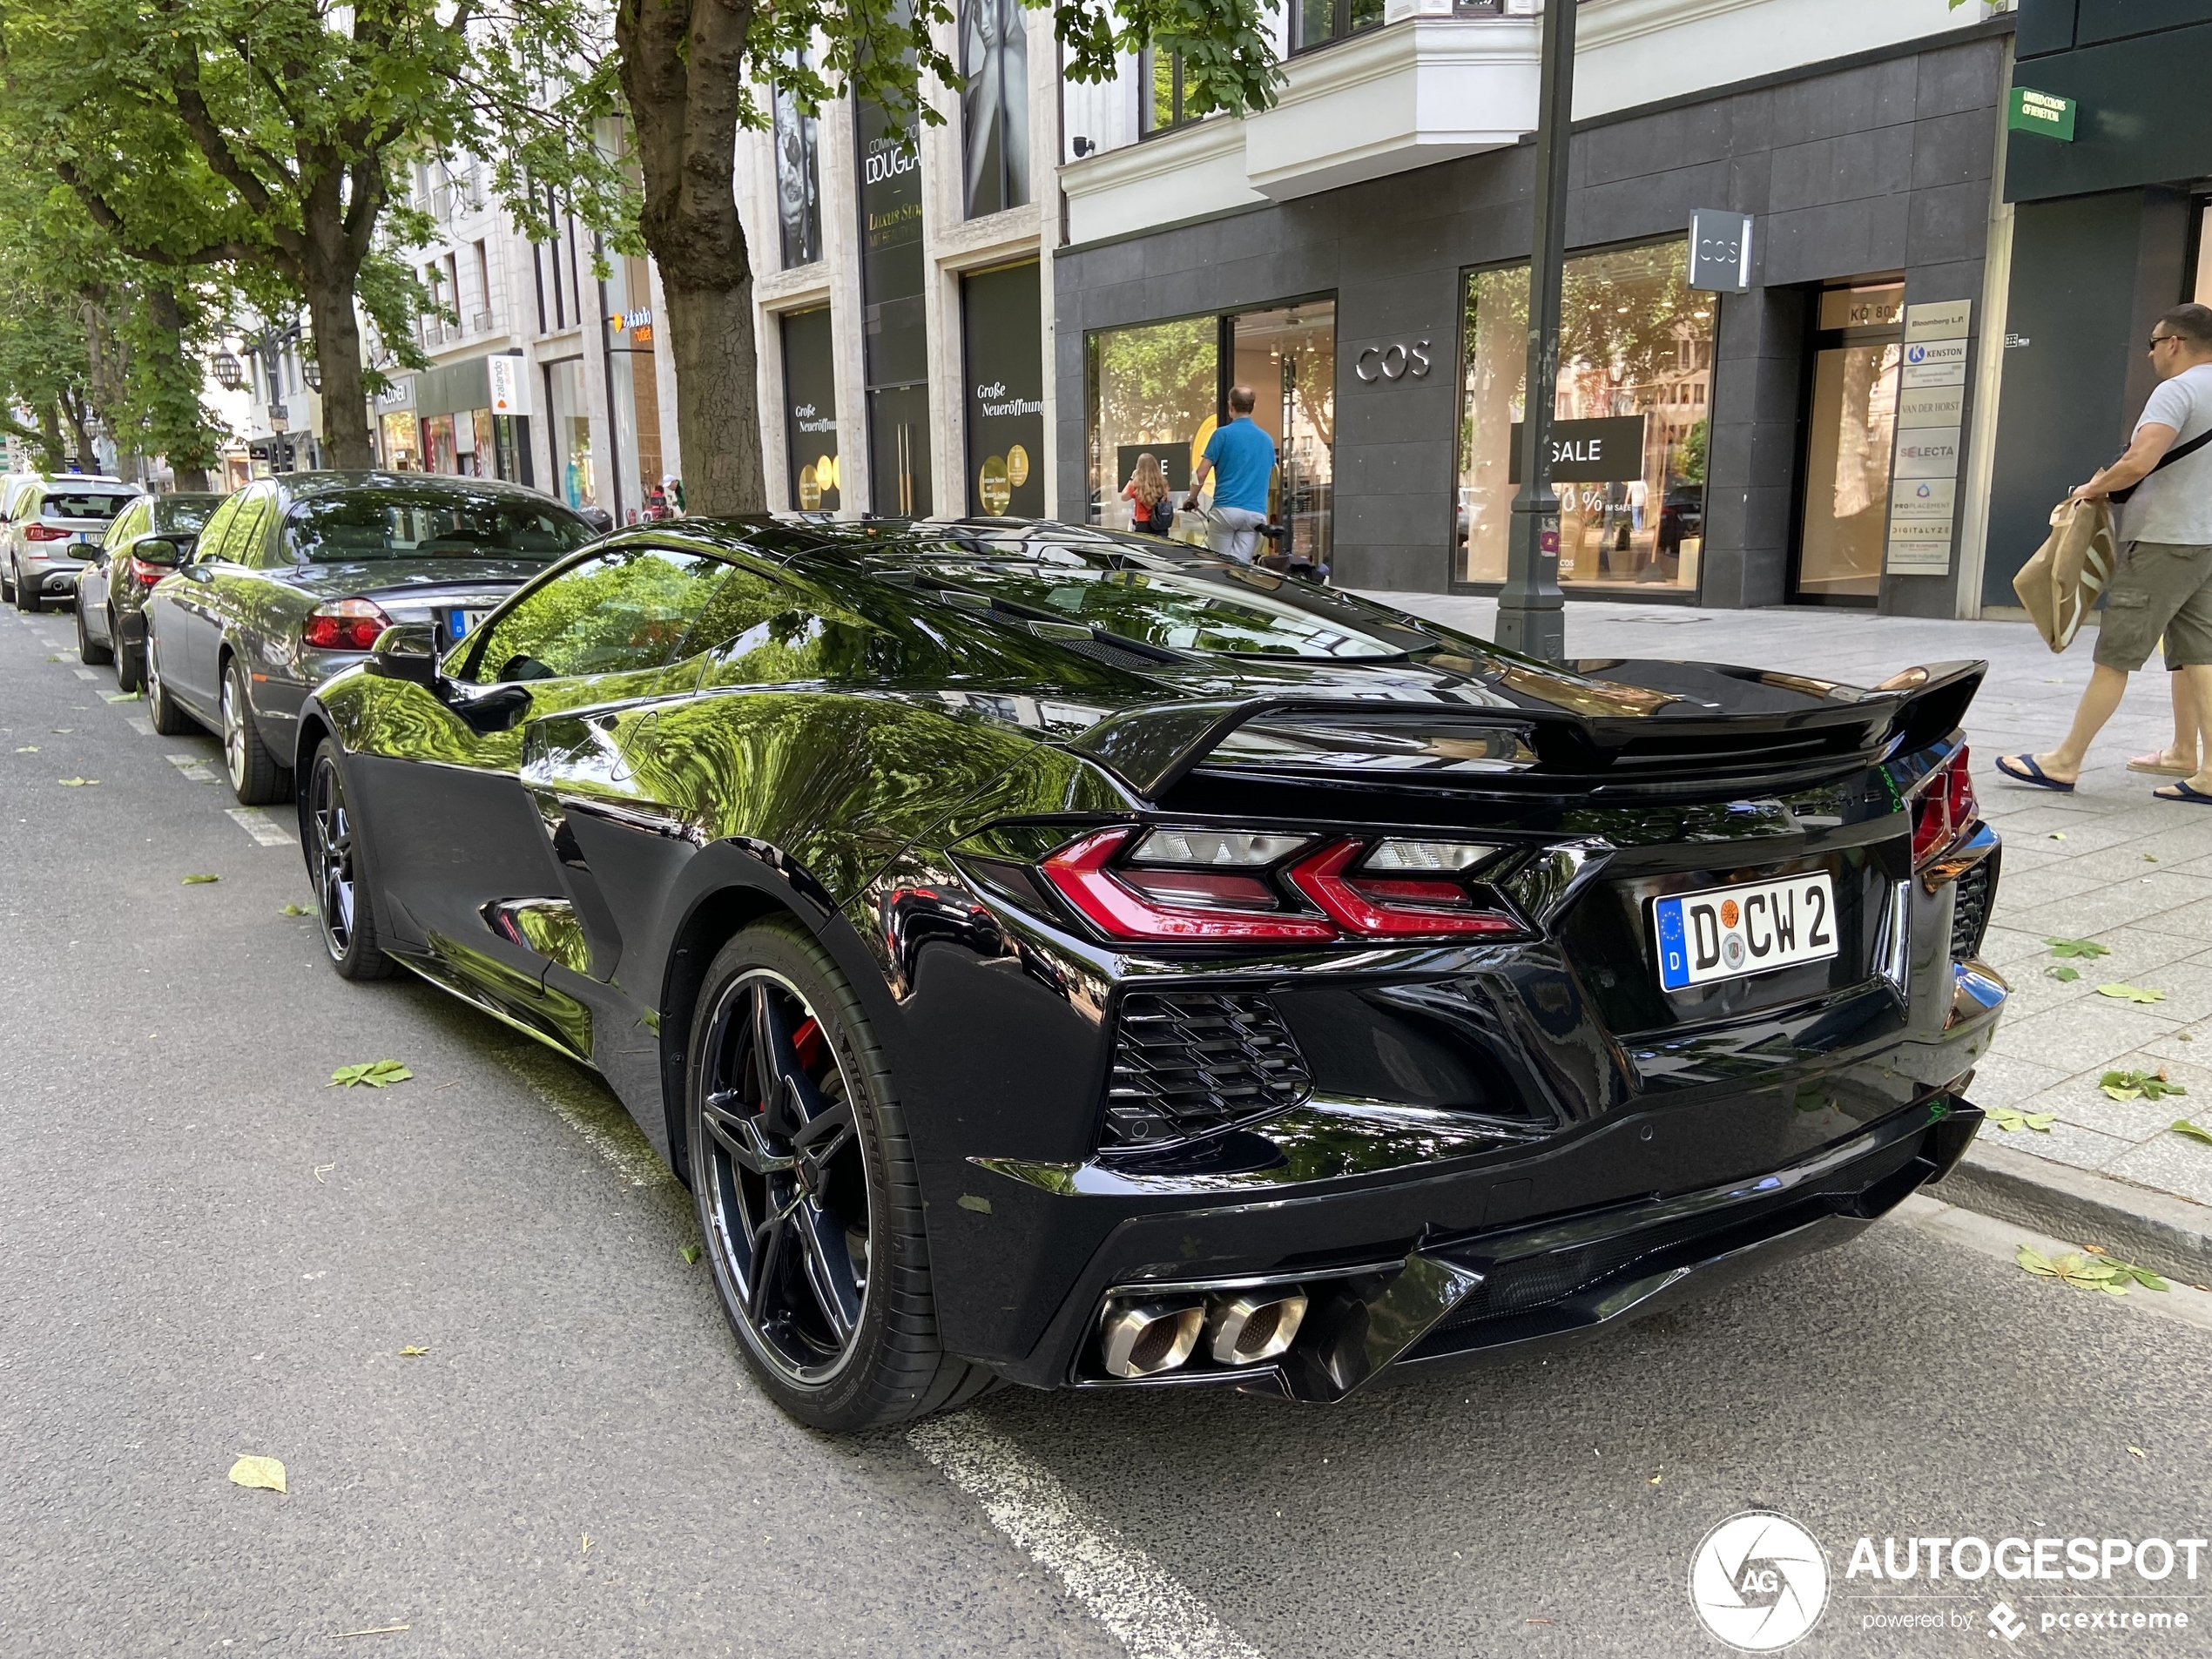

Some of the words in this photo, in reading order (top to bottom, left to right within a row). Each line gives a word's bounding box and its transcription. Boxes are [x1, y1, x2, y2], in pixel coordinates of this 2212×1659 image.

[2022, 103, 2031, 114] OF
[2023, 91, 2044, 105] UNITED
[2044, 96, 2066, 111] COLORS
[869, 209, 900, 231] Luxus
[1700, 239, 1738, 264] COS
[1876, 306, 1891, 319] 80
[1912, 319, 1950, 327] Bloomberg
[1356, 340, 1430, 381] COS
[1926, 347, 1962, 358] KENSTON
[495, 361, 505, 398] zalando
[977, 381, 1005, 400] Große
[795, 403, 815, 418] Große
[1902, 404, 1917, 414] VAN
[1919, 403, 1933, 413] DER
[1935, 401, 1960, 412] HORST
[1552, 439, 1602, 462] SALE
[1900, 446, 1953, 458] SELECTA
[1690, 903, 1721, 970] D
[1743, 889, 1796, 958] CW
[1805, 885, 1831, 948] 2
[1669, 951, 1680, 971] D
[843, 1049, 883, 1182] MICHELIN
